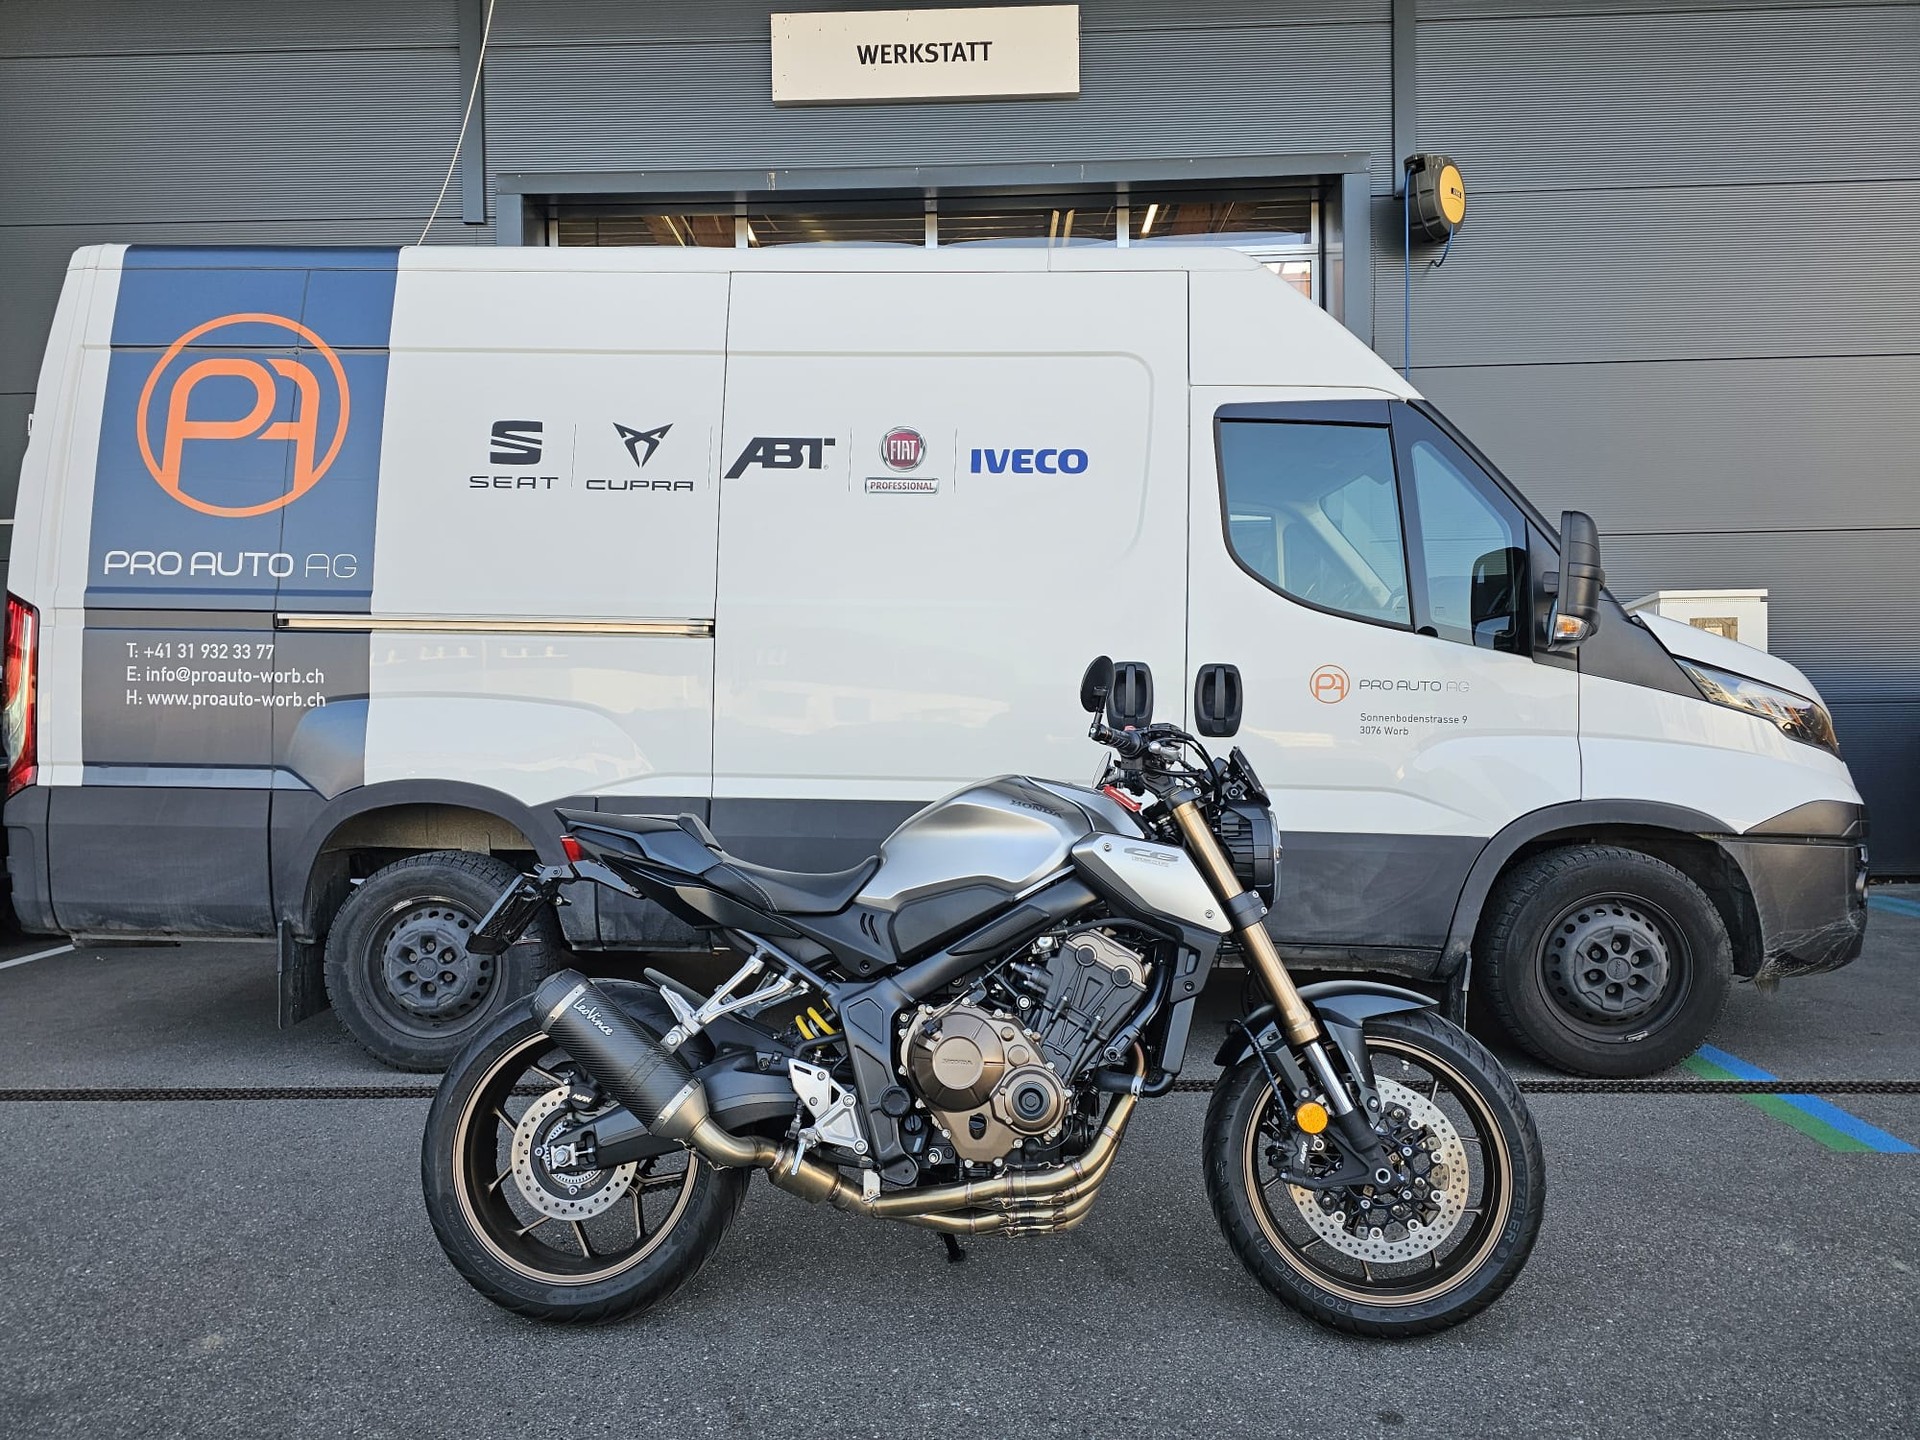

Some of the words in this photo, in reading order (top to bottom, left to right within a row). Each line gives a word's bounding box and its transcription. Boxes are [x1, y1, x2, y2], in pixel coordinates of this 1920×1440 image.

[857, 41, 993, 65] WERKSTATT
[724, 437, 836, 479] ABT
[890, 439, 918, 462] FIAT
[970, 448, 1089, 474] IVECO
[469, 475, 559, 489] SEAT
[586, 479, 694, 492] CUPRA
[869, 481, 934, 491] PROFESSIONAL
[104, 550, 183, 576] PRO
[190, 551, 294, 578] AUTO
[305, 553, 358, 579] AG
[126, 642, 138, 658] T:
[143, 643, 171, 659] +41
[177, 643, 194, 659] 31
[201, 643, 229, 660] 932
[232, 644, 251, 660] 33
[256, 644, 275, 660] 77
[126, 666, 141, 682] E:
[146, 666, 325, 686] info@proauto-worb.ch
[1359, 679, 1393, 691] PRO
[1396, 680, 1442, 692] AUTO
[1446, 681, 1470, 692] AG
[126, 689, 142, 705] H:
[147, 691, 326, 710] www.proauto-worb.ch
[1360, 713, 1460, 724] Sonnenbodenstrasse
[1461, 715, 1468, 724] 9
[1359, 726, 1382, 735] 3076
[1384, 726, 1409, 736] Worb
[1010, 799, 1063, 819] HONDA
[572, 997, 615, 1037] LeoVince
[1505, 1144, 1527, 1244] METZELER
[1274, 1260, 1350, 1314] ROADTEC
